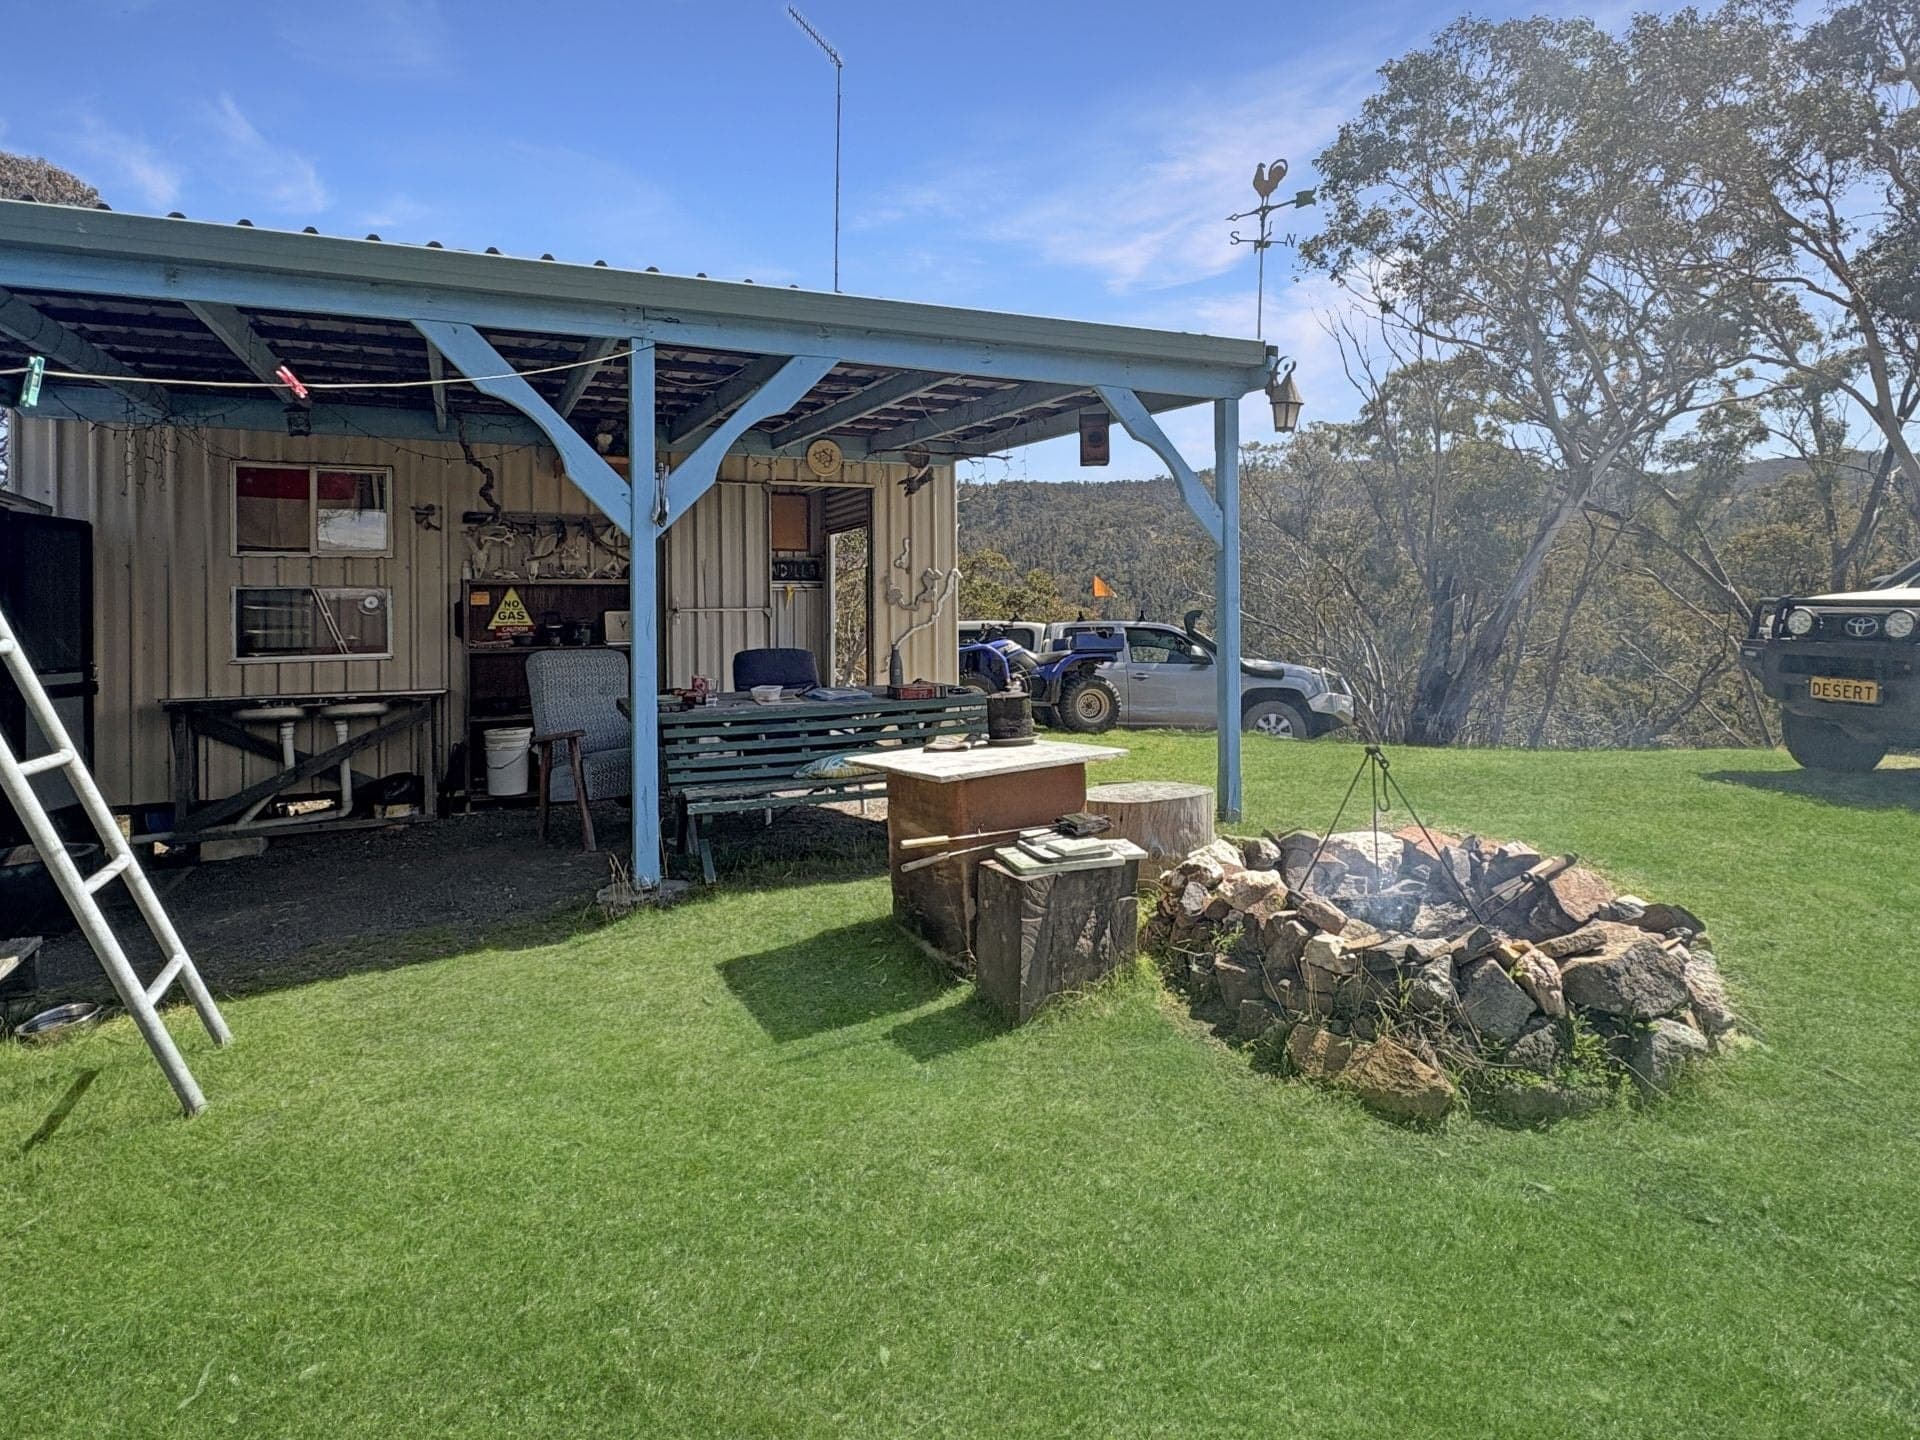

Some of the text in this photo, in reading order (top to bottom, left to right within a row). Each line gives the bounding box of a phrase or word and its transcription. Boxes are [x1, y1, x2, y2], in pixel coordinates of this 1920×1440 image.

[1230, 231, 1240, 245] S
[1285, 233, 1296, 248] N
[504, 600, 519, 608] NO
[498, 611, 525, 620] GAS
[1812, 682, 1874, 700] DESERT
